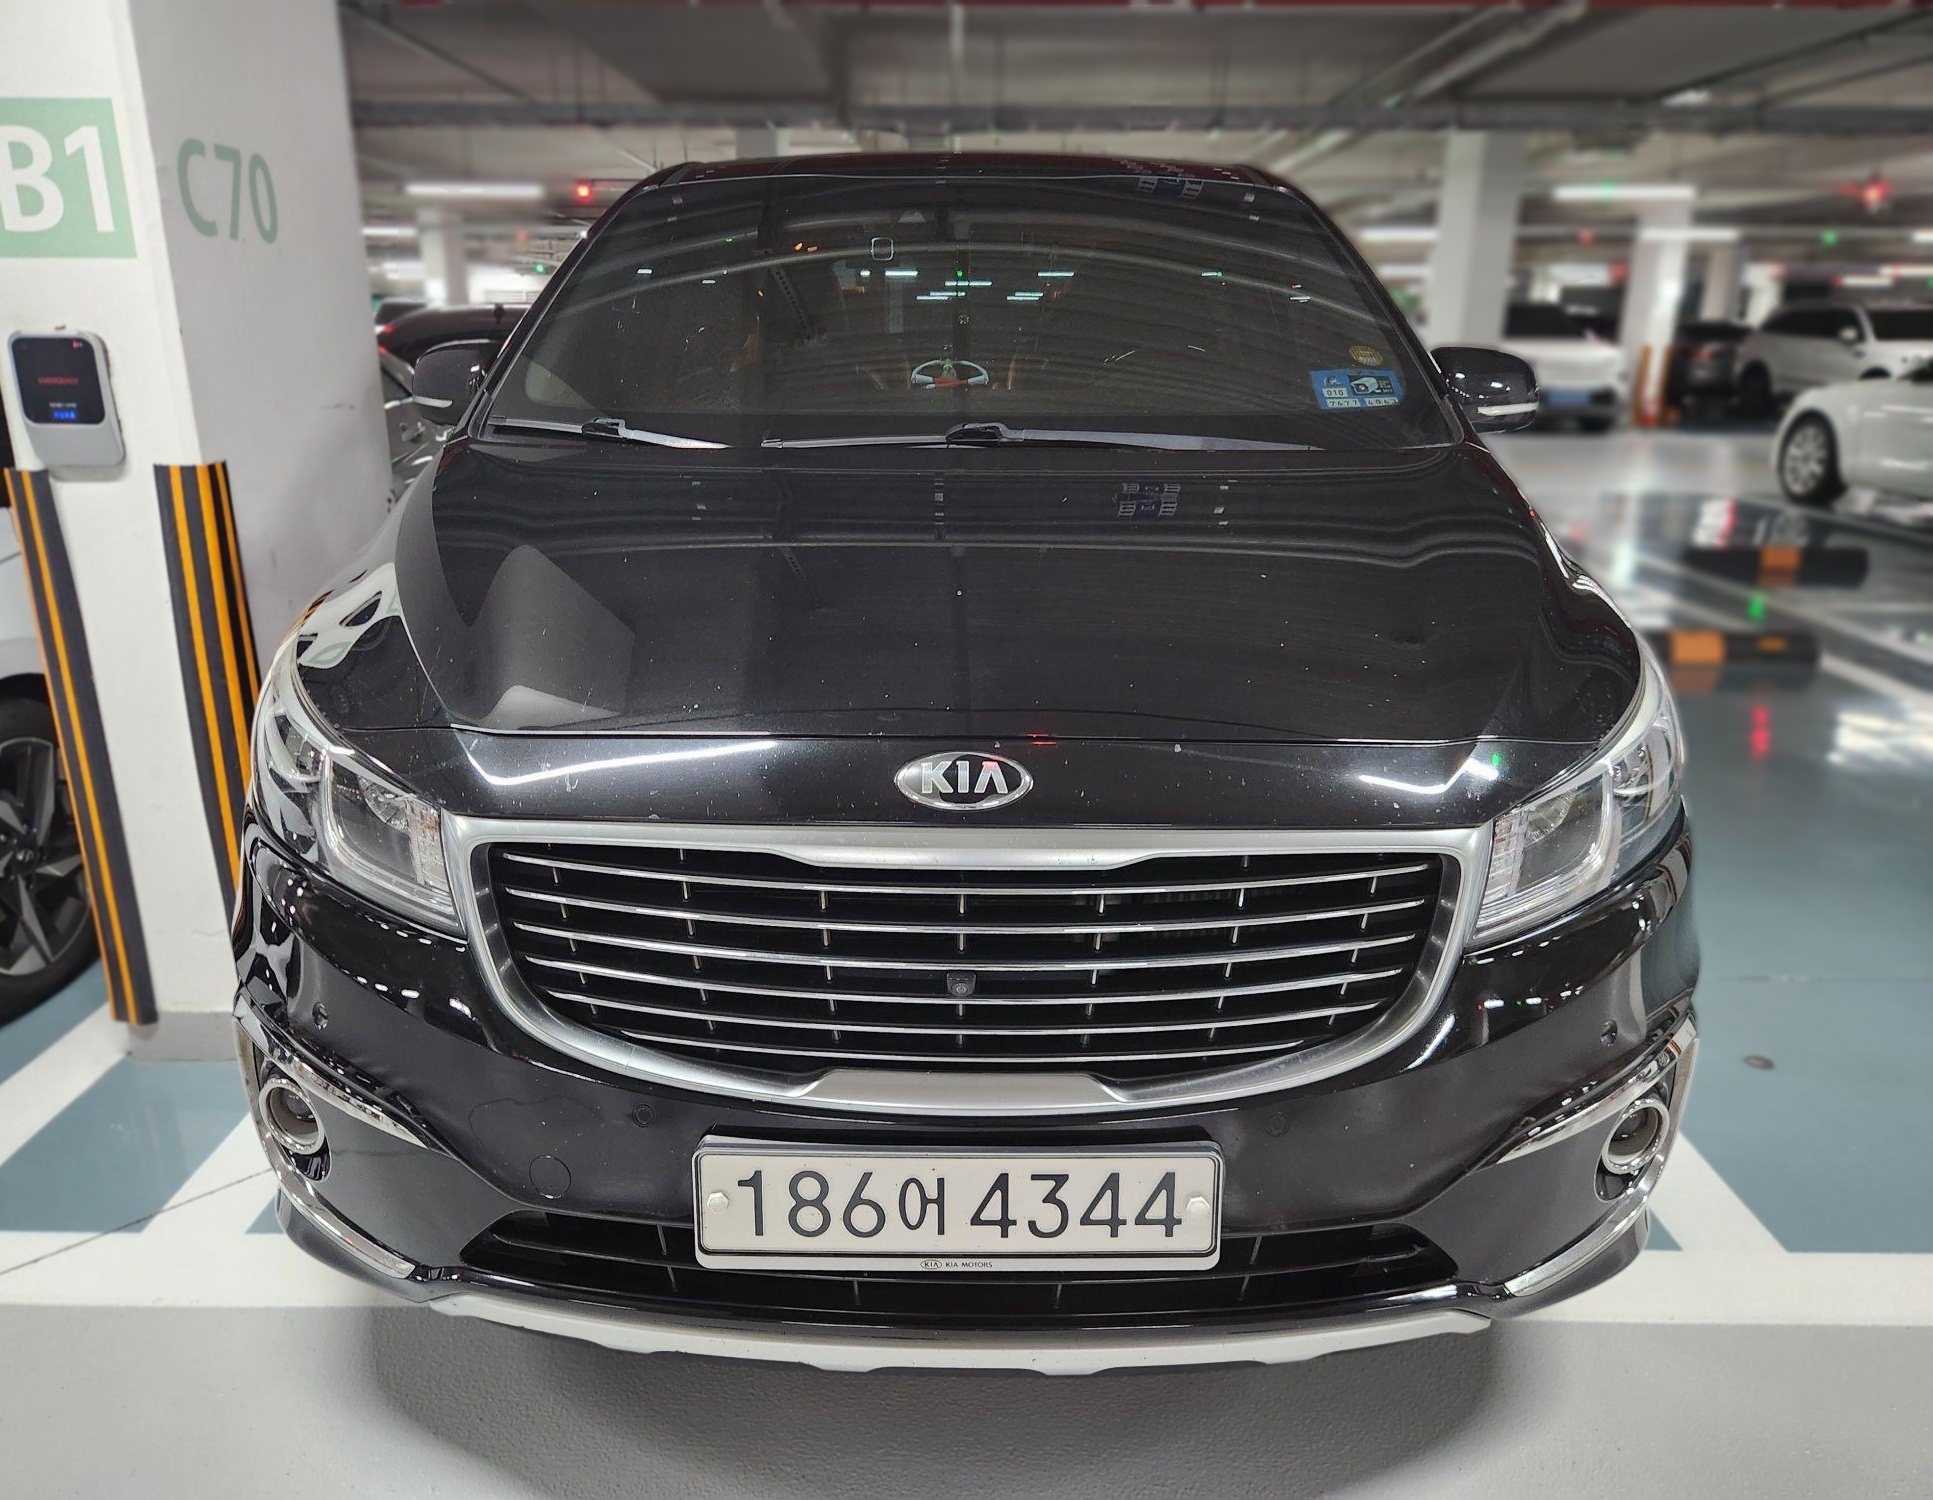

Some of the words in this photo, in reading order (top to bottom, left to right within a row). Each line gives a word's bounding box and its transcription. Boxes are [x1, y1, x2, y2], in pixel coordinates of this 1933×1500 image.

[0, 125, 115, 233] B1
[177, 138, 278, 244] C70
[1326, 388, 1344, 397] 010
[921, 760, 1009, 794] KIA
[737, 1169, 945, 1239] 186어
[969, 1171, 1183, 1239] 4344
